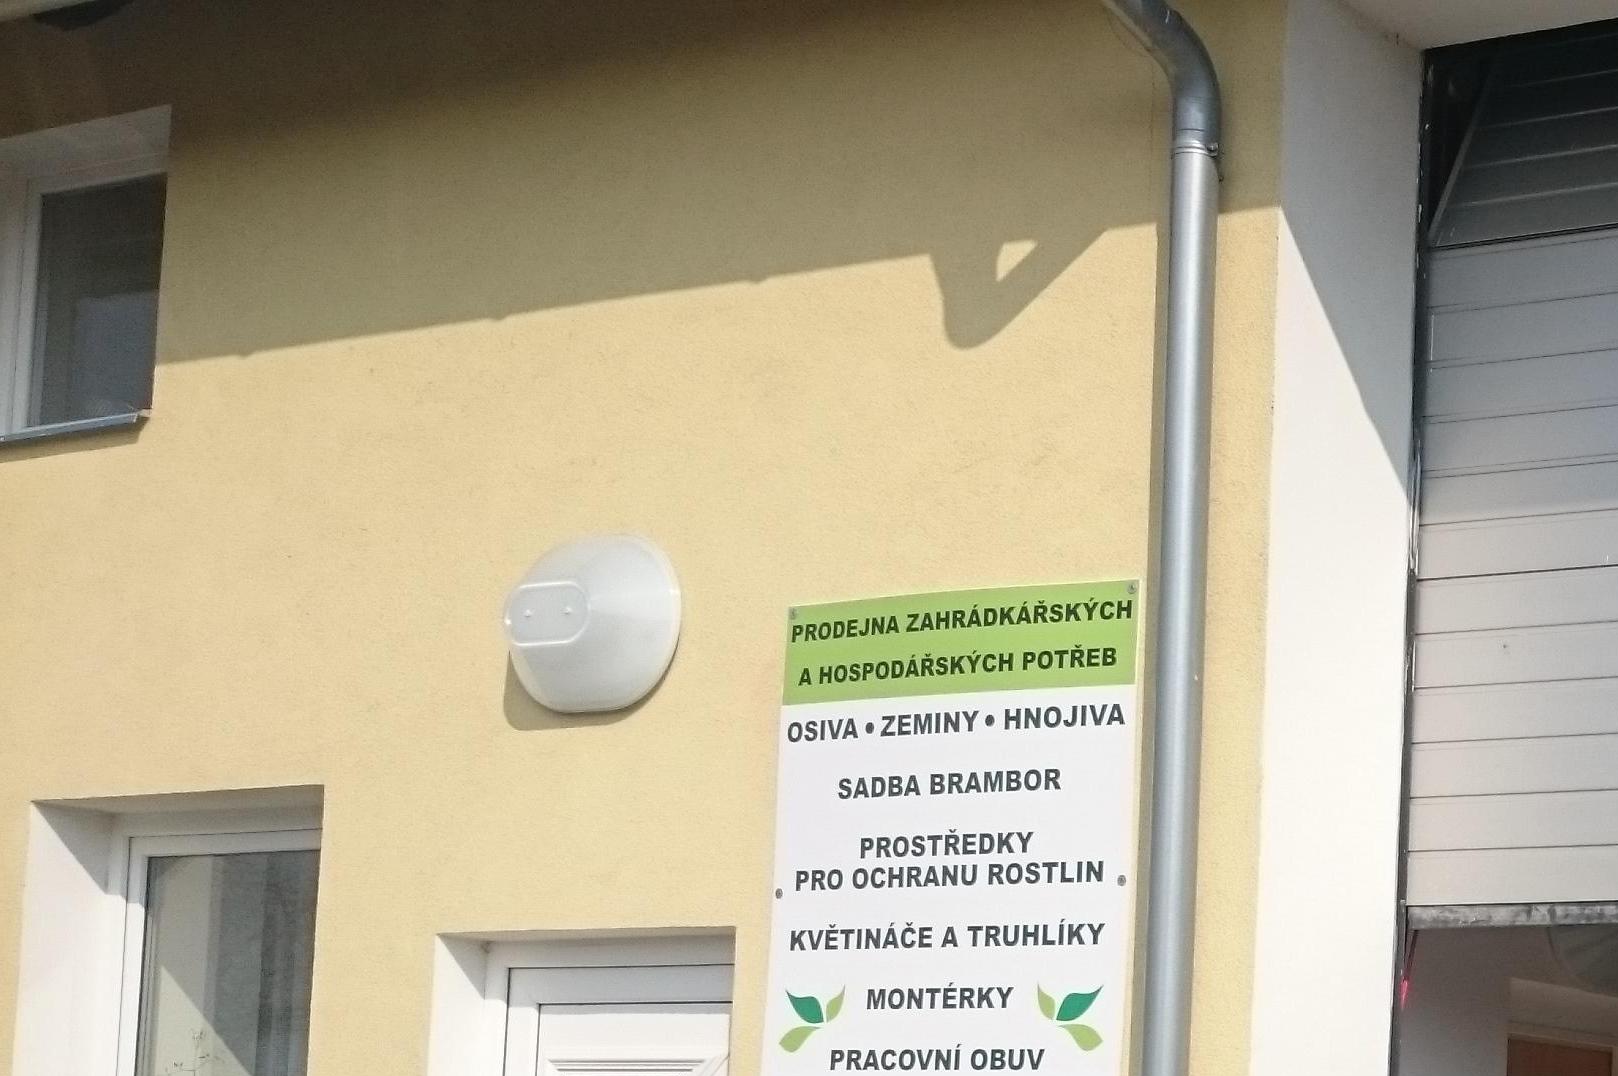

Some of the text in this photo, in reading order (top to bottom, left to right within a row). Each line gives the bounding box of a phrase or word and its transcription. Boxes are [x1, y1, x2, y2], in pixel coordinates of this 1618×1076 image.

[792, 598, 1132, 642] PRODEJNA ZAHRÁDKÁŘSKÝCH
[798, 645, 1116, 685] A HOSPODÁŘSKÝCH POTŘEB
[788, 704, 1125, 742] OSIVA ZEMINY HNOJIVA
[838, 769, 1061, 799] SADBA BRAMBOR
[861, 829, 1033, 859] PROSTŘEDKY
[796, 861, 1103, 891] PRO OCHRANU ROSTLIN
[790, 919, 1105, 951] KVĚTINÁČE A TRUHLÍKY
[867, 983, 1013, 1009] MONTÉRKY
[830, 1044, 1044, 1070] PRACOVNÍ OBUV
